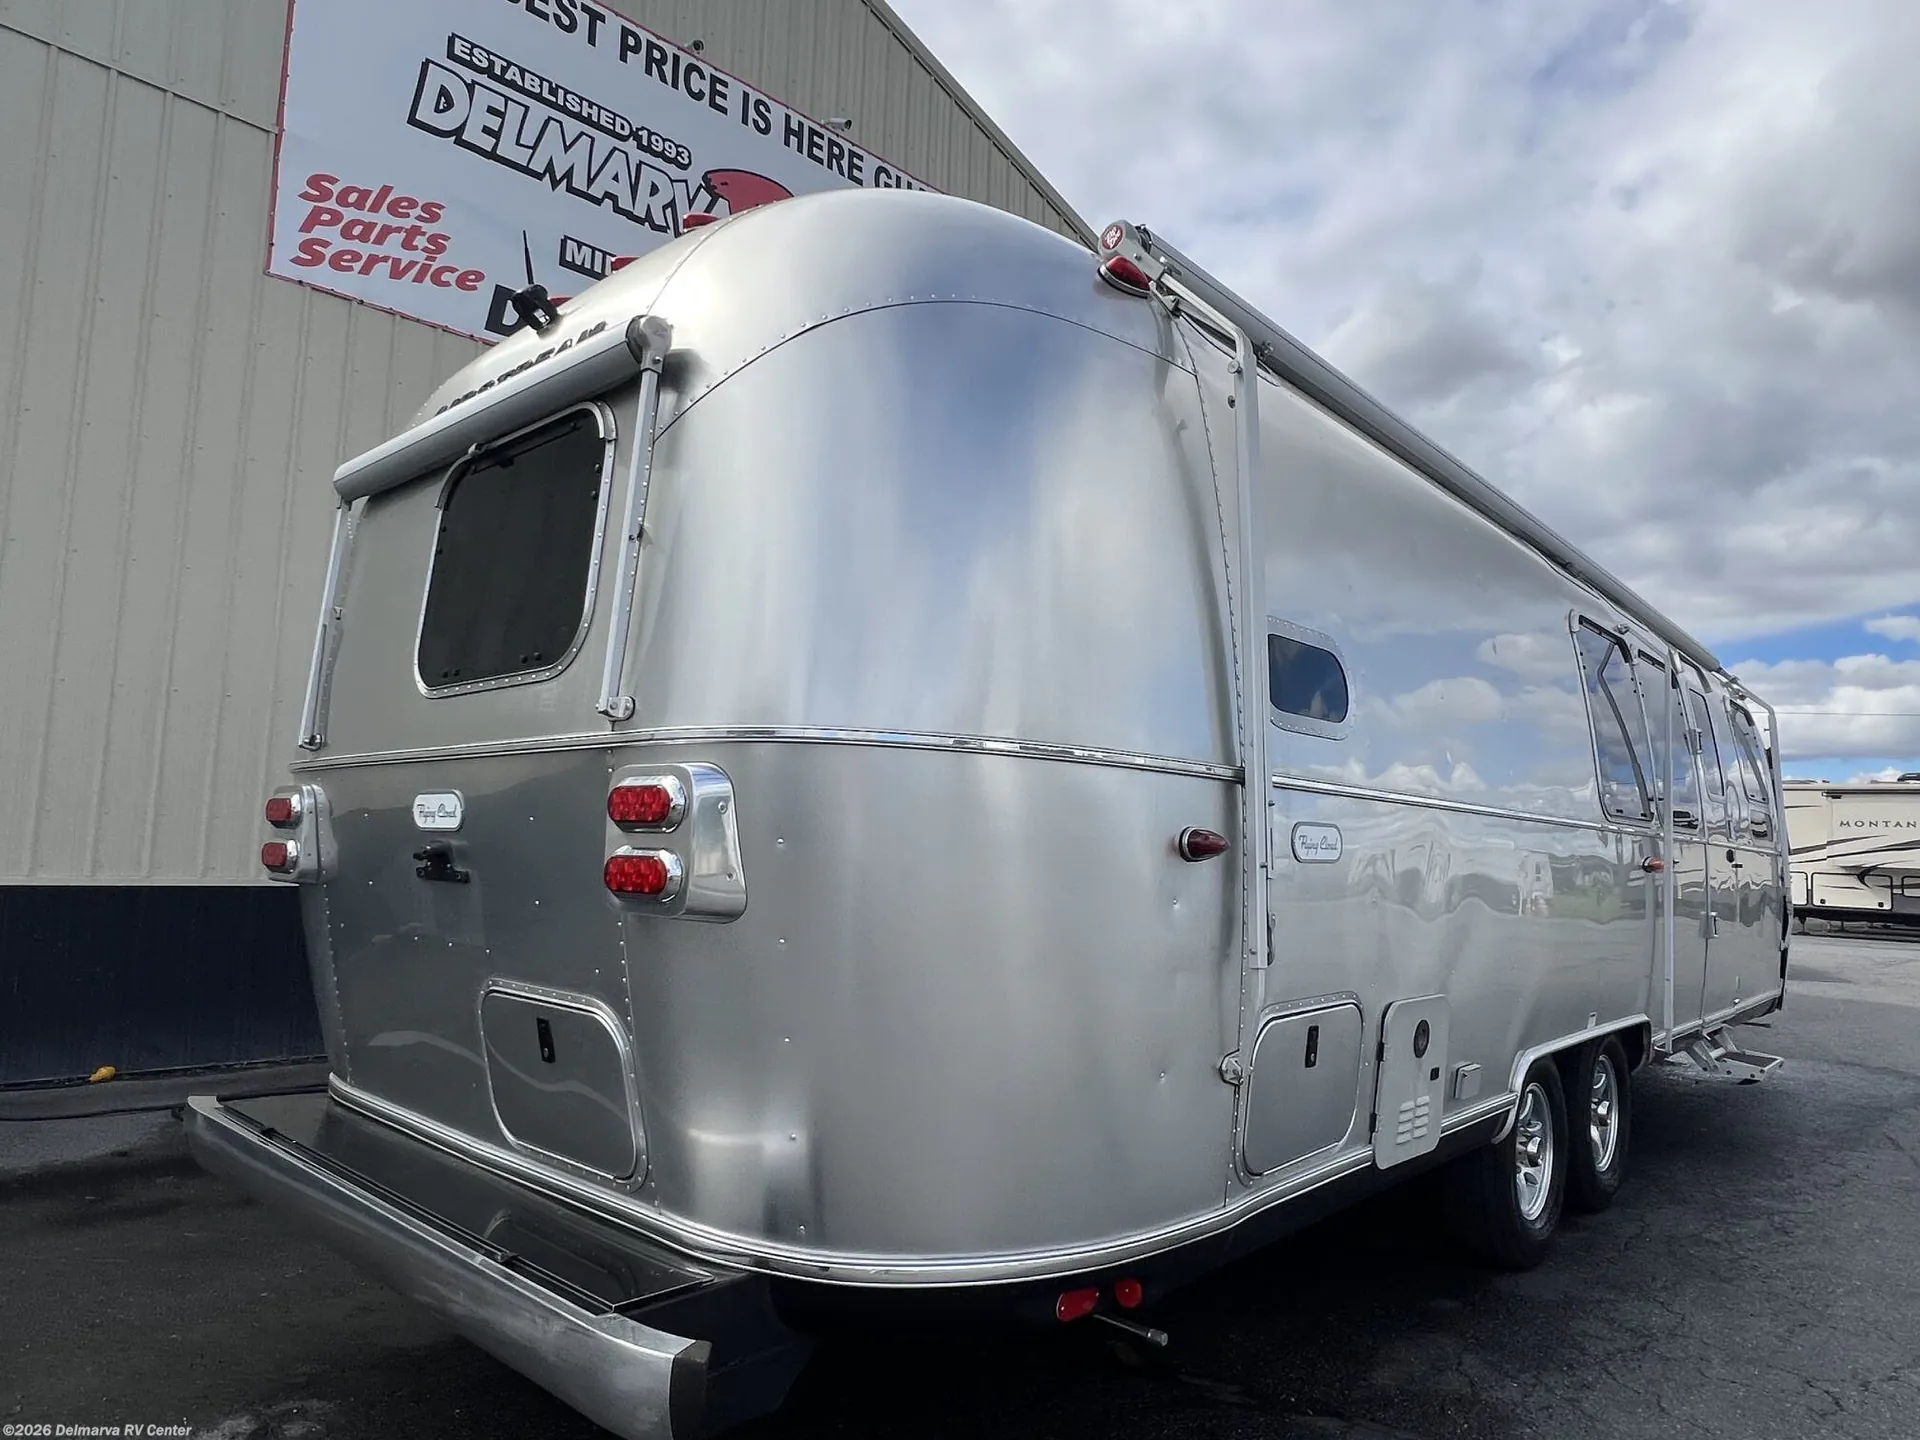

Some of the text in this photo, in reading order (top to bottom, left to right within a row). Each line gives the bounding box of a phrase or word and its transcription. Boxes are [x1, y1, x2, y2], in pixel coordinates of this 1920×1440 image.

[453, 39, 691, 167] ESTABLISHED 1993
[506, 0, 606, 48] EST
[618, 25, 729, 116] PRICE
[740, 89, 773, 137] IS
[783, 114, 864, 188] HERE
[297, 173, 447, 224] Sales
[297, 204, 452, 256] Parts
[289, 237, 486, 292] Service
